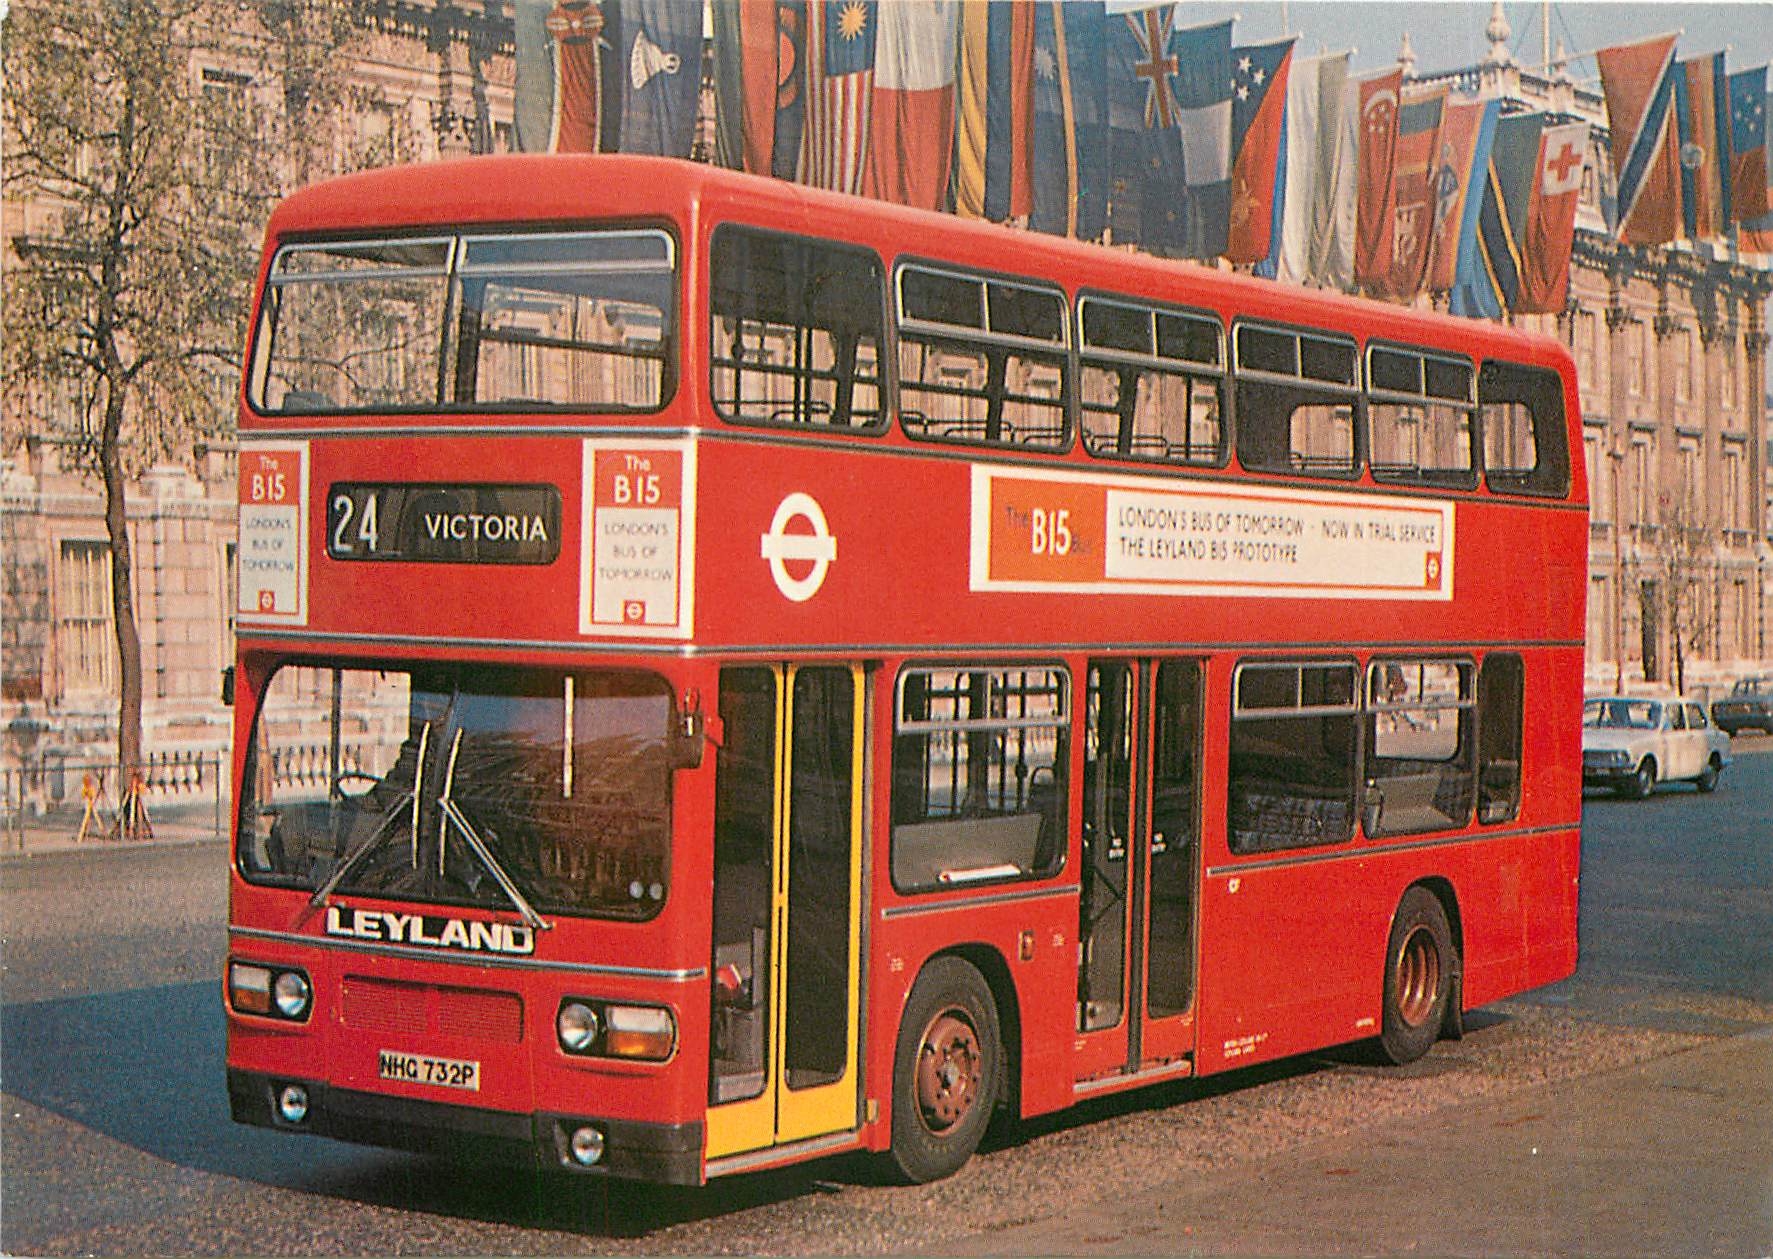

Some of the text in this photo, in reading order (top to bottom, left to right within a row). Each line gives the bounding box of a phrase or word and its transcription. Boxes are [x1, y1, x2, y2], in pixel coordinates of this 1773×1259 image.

[260, 457, 279, 470] The
[625, 454, 651, 471] The
[334, 495, 378, 552] 24
[424, 514, 548, 542] VICTORIA
[1032, 507, 1073, 556] B15
[1191, 511, 1212, 532] BUS
[1216, 512, 1232, 533] OF
[1236, 513, 1304, 537] TOMORROW
[1322, 519, 1349, 539] NOW
[1353, 521, 1363, 539] IN
[1368, 521, 1396, 542] TRIAL
[1400, 524, 1436, 544] SERVICE
[613, 545, 657, 558] BUS OF
[1120, 536, 1144, 558] THE
[1150, 537, 1206, 560] LEYLAND
[1233, 540, 1298, 563] PROTOTYPE
[599, 567, 673, 581] TOMORROW
[326, 906, 535, 955] LEYLAND
[423, 1060, 474, 1085] 732P
